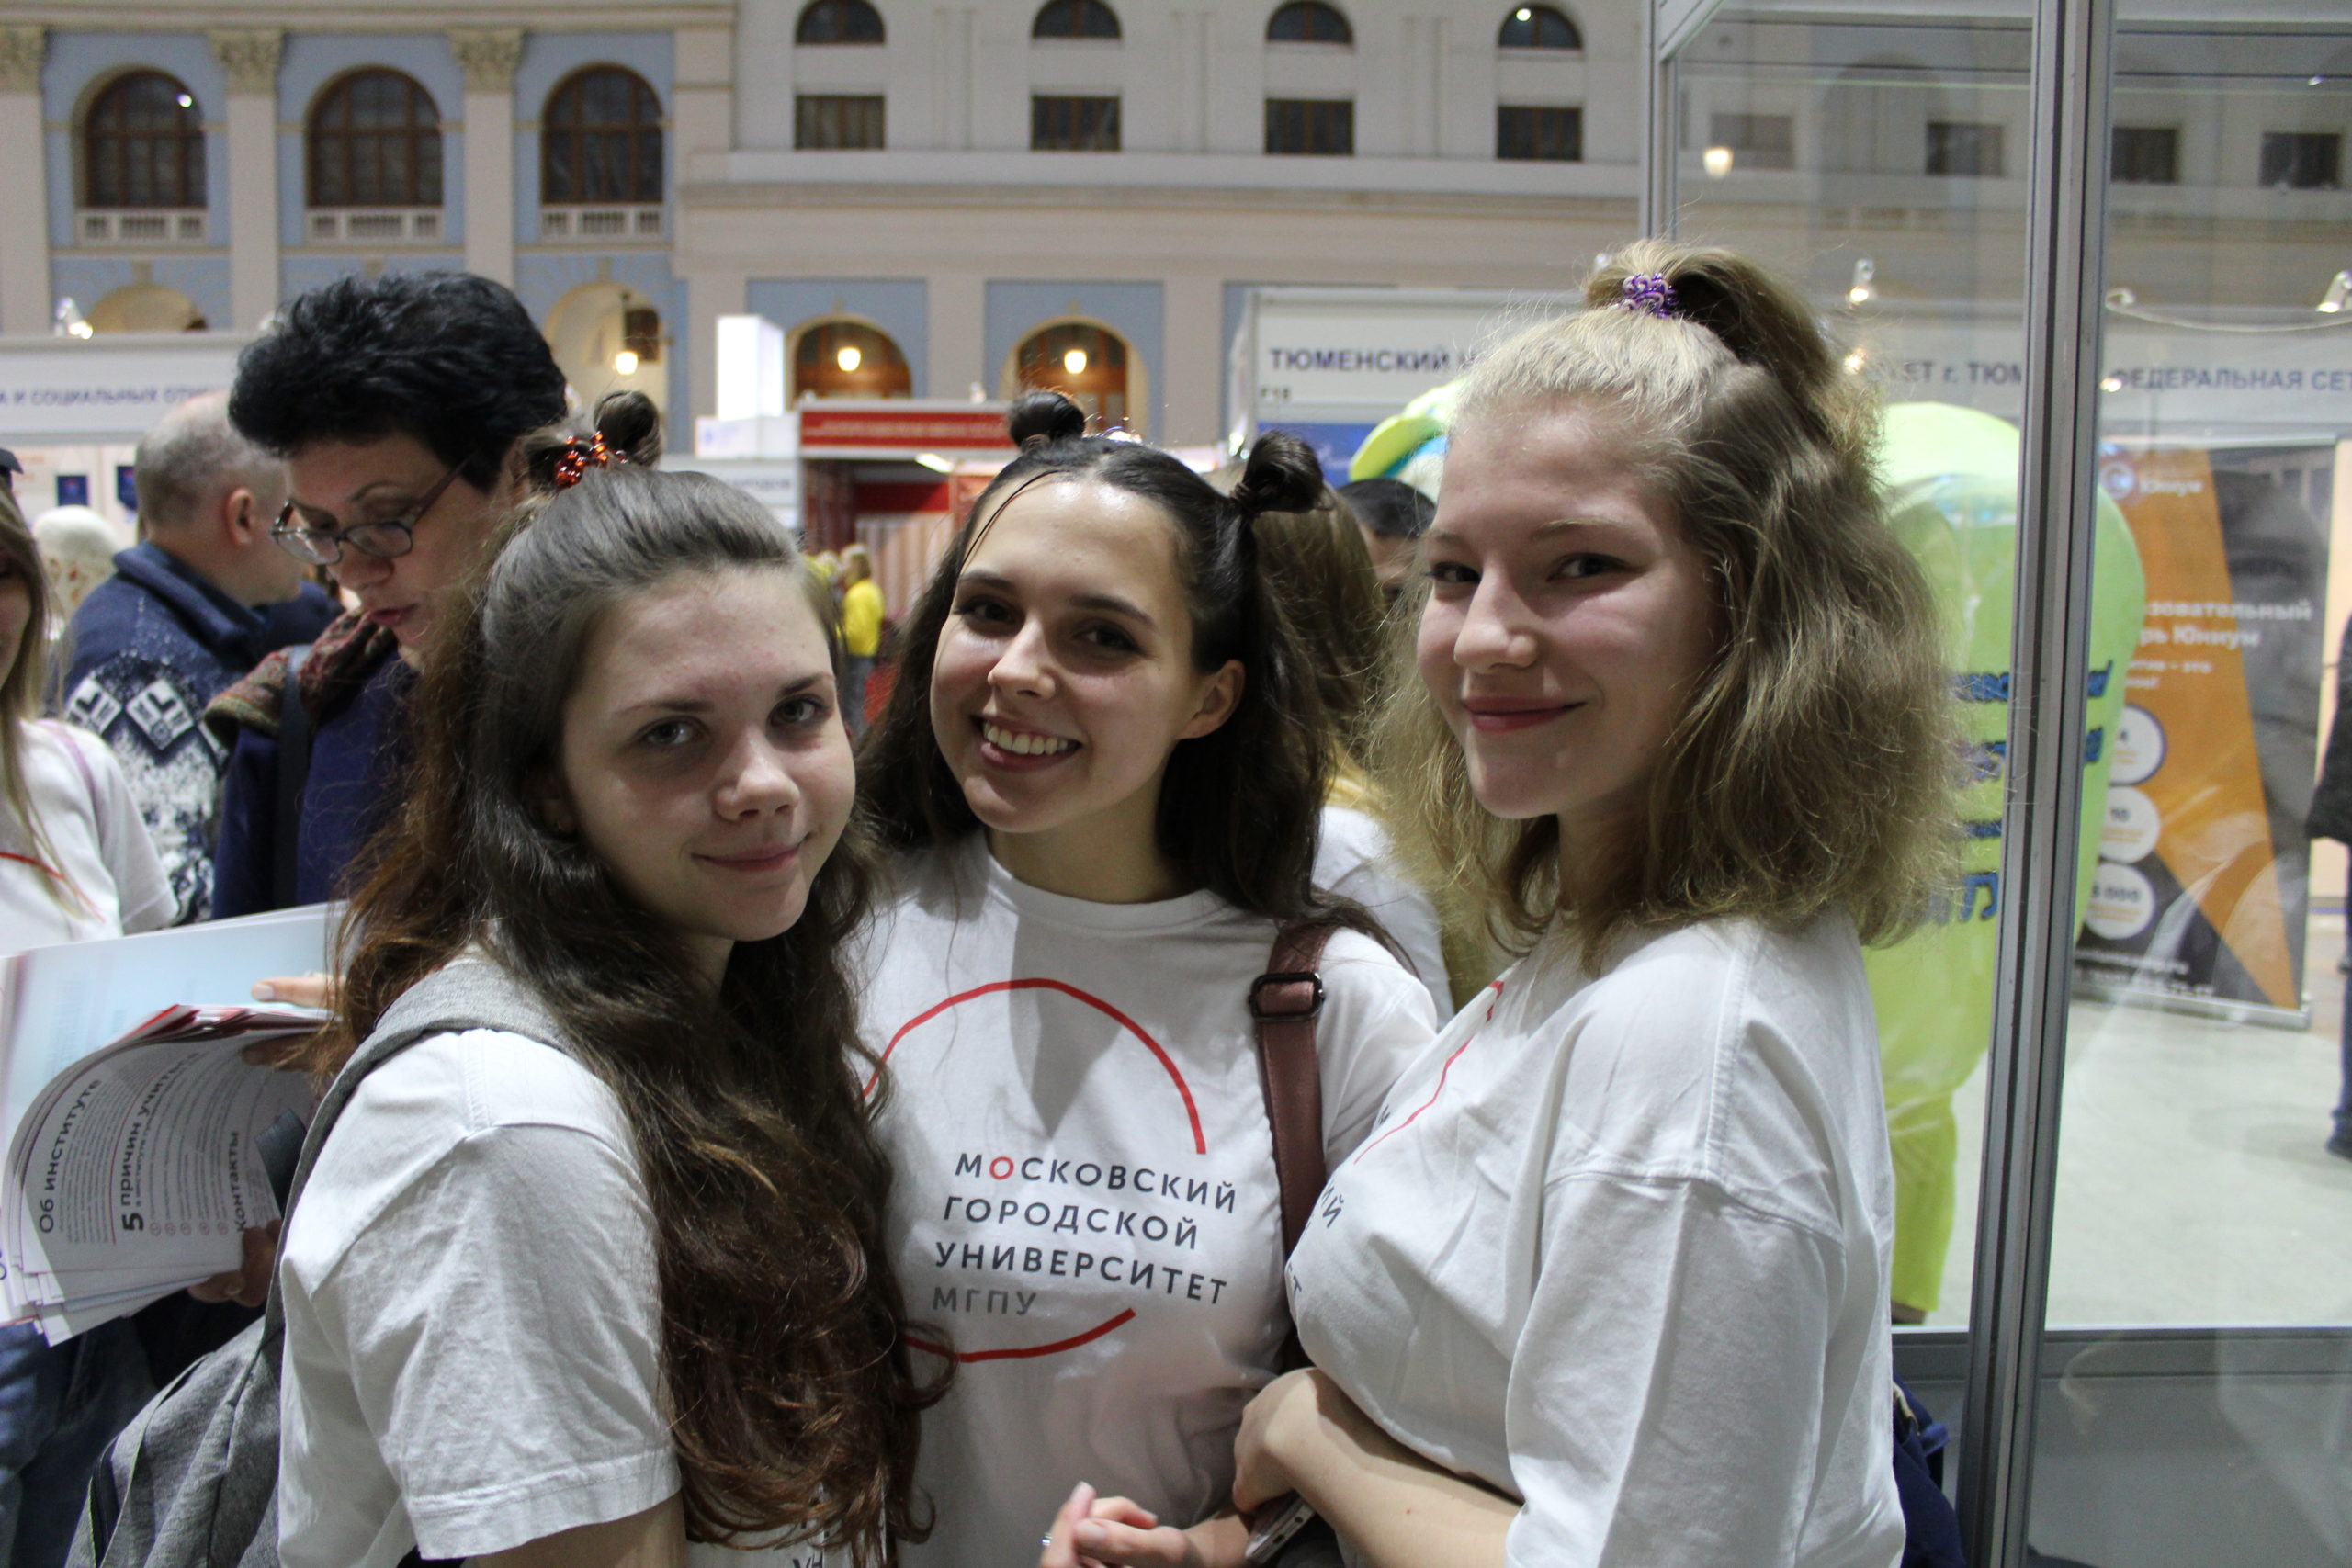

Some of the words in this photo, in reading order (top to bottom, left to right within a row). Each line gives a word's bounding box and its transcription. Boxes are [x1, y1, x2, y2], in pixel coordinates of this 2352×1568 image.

[1270, 344, 1450, 373] ТЮМЕНСКИЙ
[2110, 367, 2302, 392] ФЕДЕРАЛЬНАЯ
[2146, 599, 2313, 621] зовательный
[2172, 625, 2261, 650] Юниум
[43, 1078, 103, 1190] институте
[119, 1122, 141, 1206] причин
[229, 1131, 247, 1233] Контакты
[955, 1152, 1237, 1214] МОСКОВСКИЙ
[39, 1198, 55, 1234] Об
[121, 1212, 144, 1233] 5
[943, 1196, 1198, 1250] ГОРОДСКОЙ
[934, 1241, 1227, 1305] УНИВЕРСИТЕТ
[932, 1287, 1037, 1316] МГПУ
